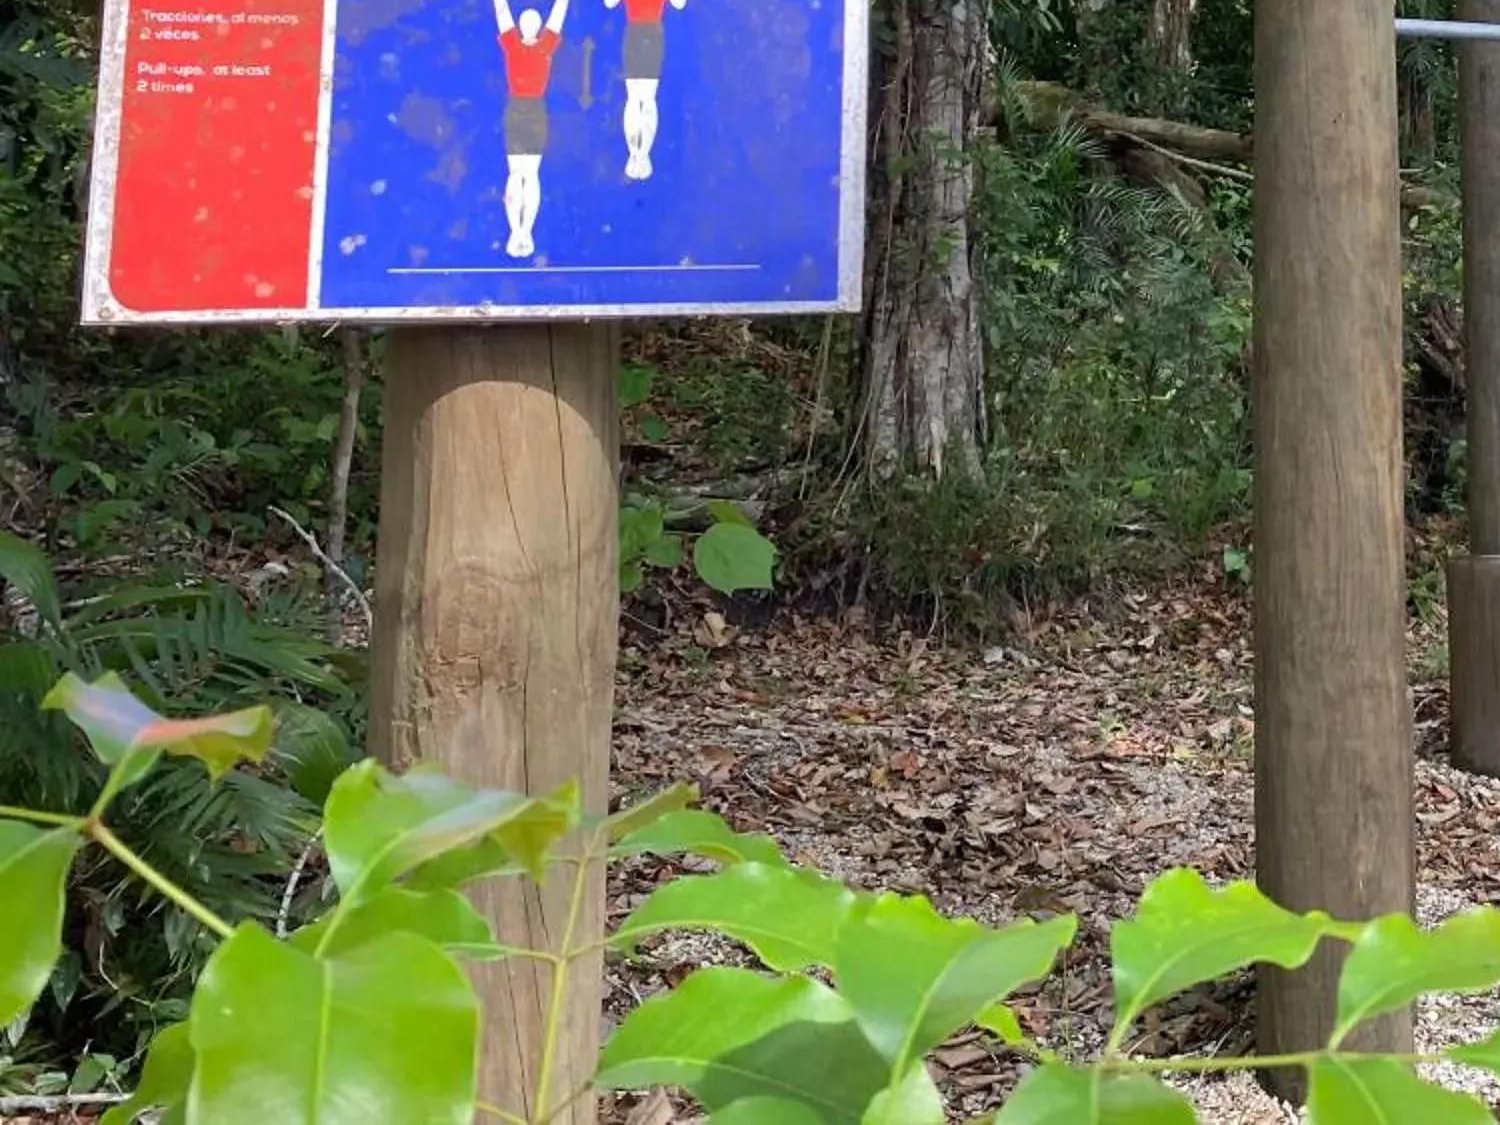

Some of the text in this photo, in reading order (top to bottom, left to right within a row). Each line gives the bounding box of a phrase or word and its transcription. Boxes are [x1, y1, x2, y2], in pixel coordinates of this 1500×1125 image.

[248, 14, 299, 25] menos
[140, 27, 199, 40] 2 veces
[212, 64, 229, 75] at
[232, 64, 271, 76] least
[136, 80, 194, 93] 2 times
